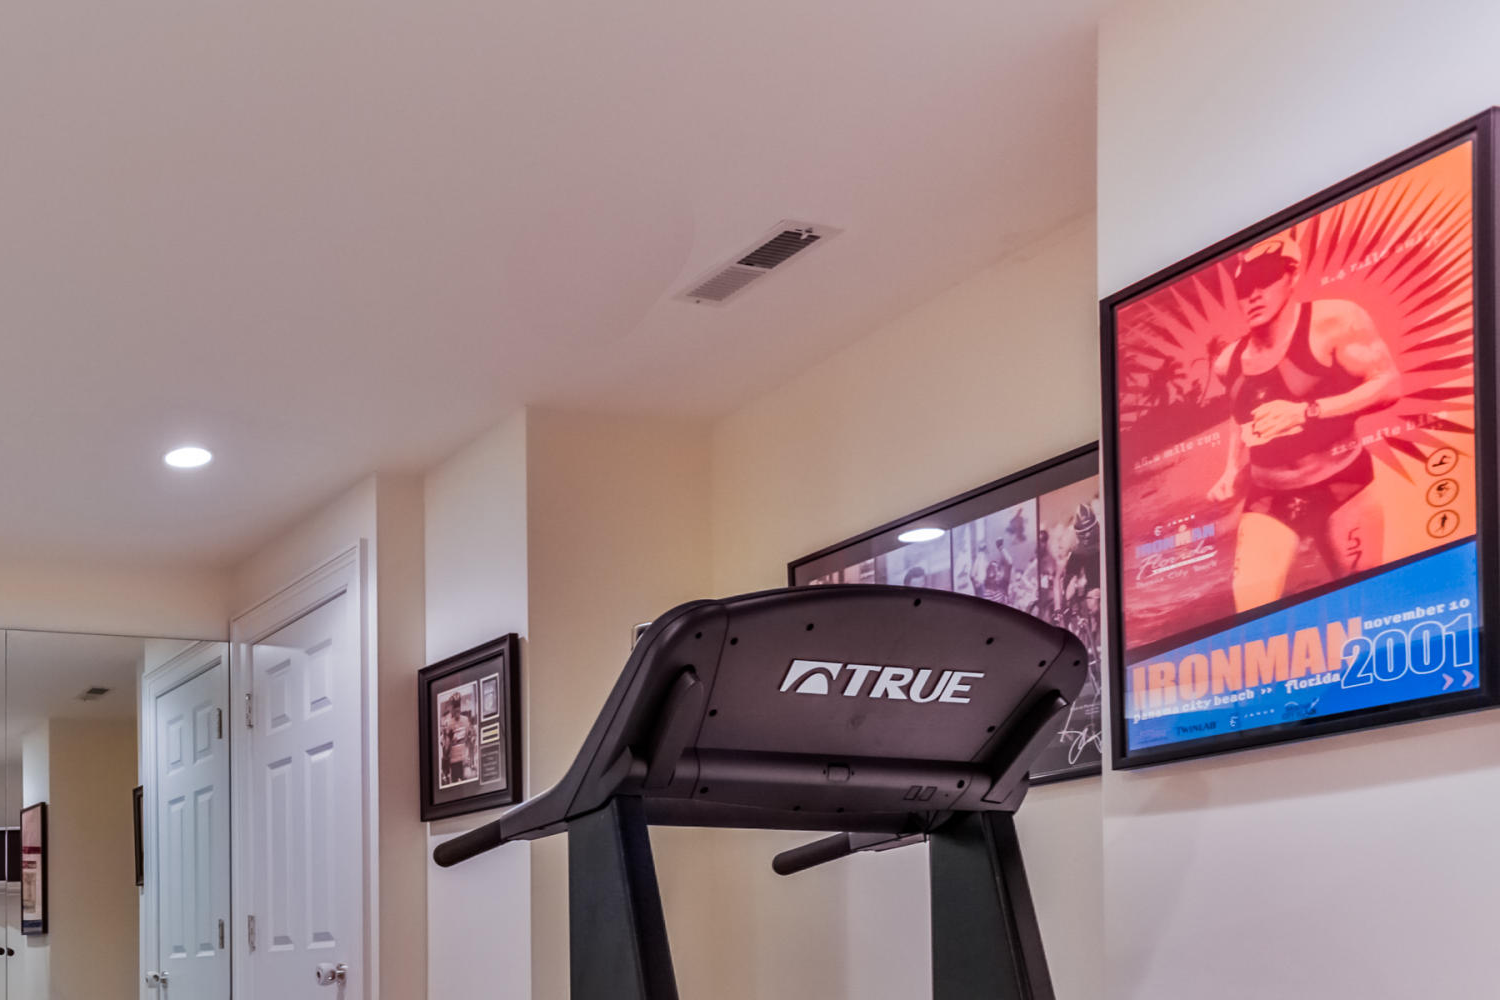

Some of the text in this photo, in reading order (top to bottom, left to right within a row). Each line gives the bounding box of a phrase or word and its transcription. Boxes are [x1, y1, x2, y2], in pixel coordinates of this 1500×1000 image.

[1362, 426, 1401, 446] mile
[1364, 598, 1470, 630] november 10
[1132, 616, 1363, 709] IRONMAN
[1340, 613, 1473, 689] 2001
[842, 663, 985, 704] TRUE
[1182, 698, 1212, 715] city
[1213, 689, 1255, 706] beach
[1285, 673, 1340, 694] florida
